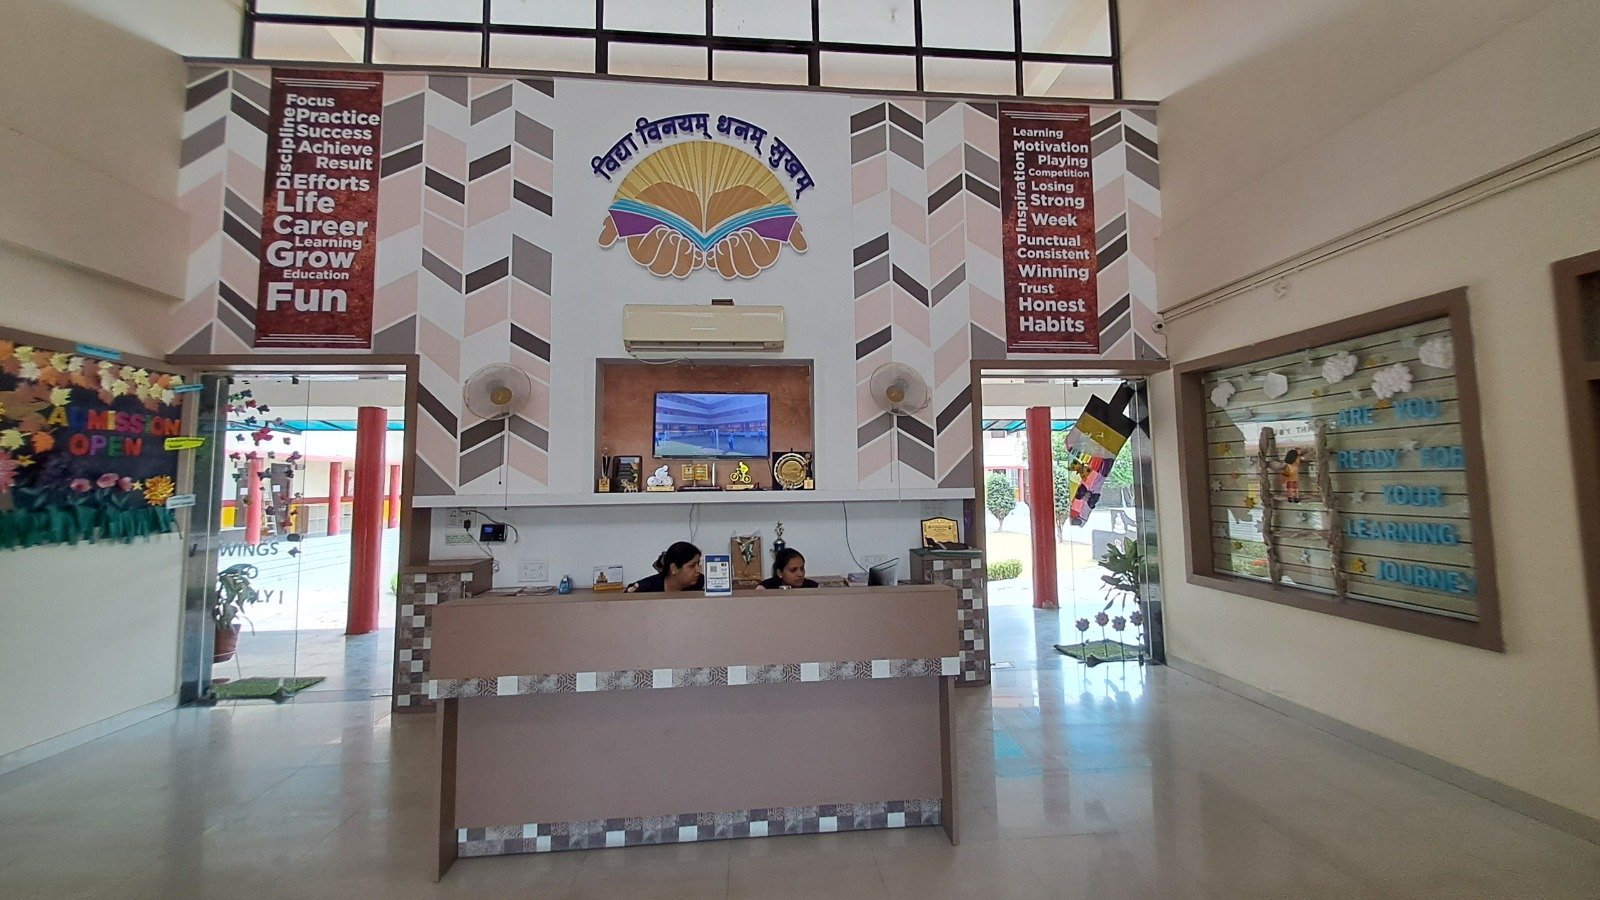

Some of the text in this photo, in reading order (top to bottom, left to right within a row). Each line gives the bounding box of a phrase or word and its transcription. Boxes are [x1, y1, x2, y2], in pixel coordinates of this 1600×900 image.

[286, 93, 336, 107] Focus
[296, 108, 381, 126] Practice
[296, 124, 373, 140] Success
[1012, 127, 1064, 139] Learning
[276, 107, 296, 190] Discipline
[298, 140, 374, 156] Achieve
[1013, 140, 1089, 154] Motivation
[316, 156, 373, 171] Result
[591, 113, 815, 199] विद्या विनयम् धनम् सुखम्
[1038, 154, 1088, 168] Playing
[1028, 168, 1090, 179] Competition
[293, 173, 370, 192] Efforts
[1031, 181, 1074, 194] Losing
[1014, 151, 1028, 232] Inspiration
[276, 191, 336, 214] Life
[1030, 193, 1085, 208] Strong
[273, 215, 369, 237] Career
[1031, 213, 1078, 227] Week
[295, 236, 363, 250] Learning
[1017, 234, 1081, 247] Punctual
[266, 240, 355, 269] Grow
[1017, 247, 1090, 260] Consistent
[283, 269, 350, 280] Education
[1018, 264, 1090, 281] Winning
[265, 281, 348, 313] Fun
[1018, 283, 1054, 294] Trust
[1018, 296, 1086, 313] Honest
[1019, 316, 1085, 333] Habits
[47, 406, 181, 436] ADMISSION
[1337, 398, 1441, 428] ARE YOU
[68, 433, 144, 457] OPEN
[1336, 445, 1466, 470] READY FOR
[1382, 484, 1445, 507] YOUR
[1345, 516, 1459, 546] LEARNING
[219, 541, 279, 557] WINGS
